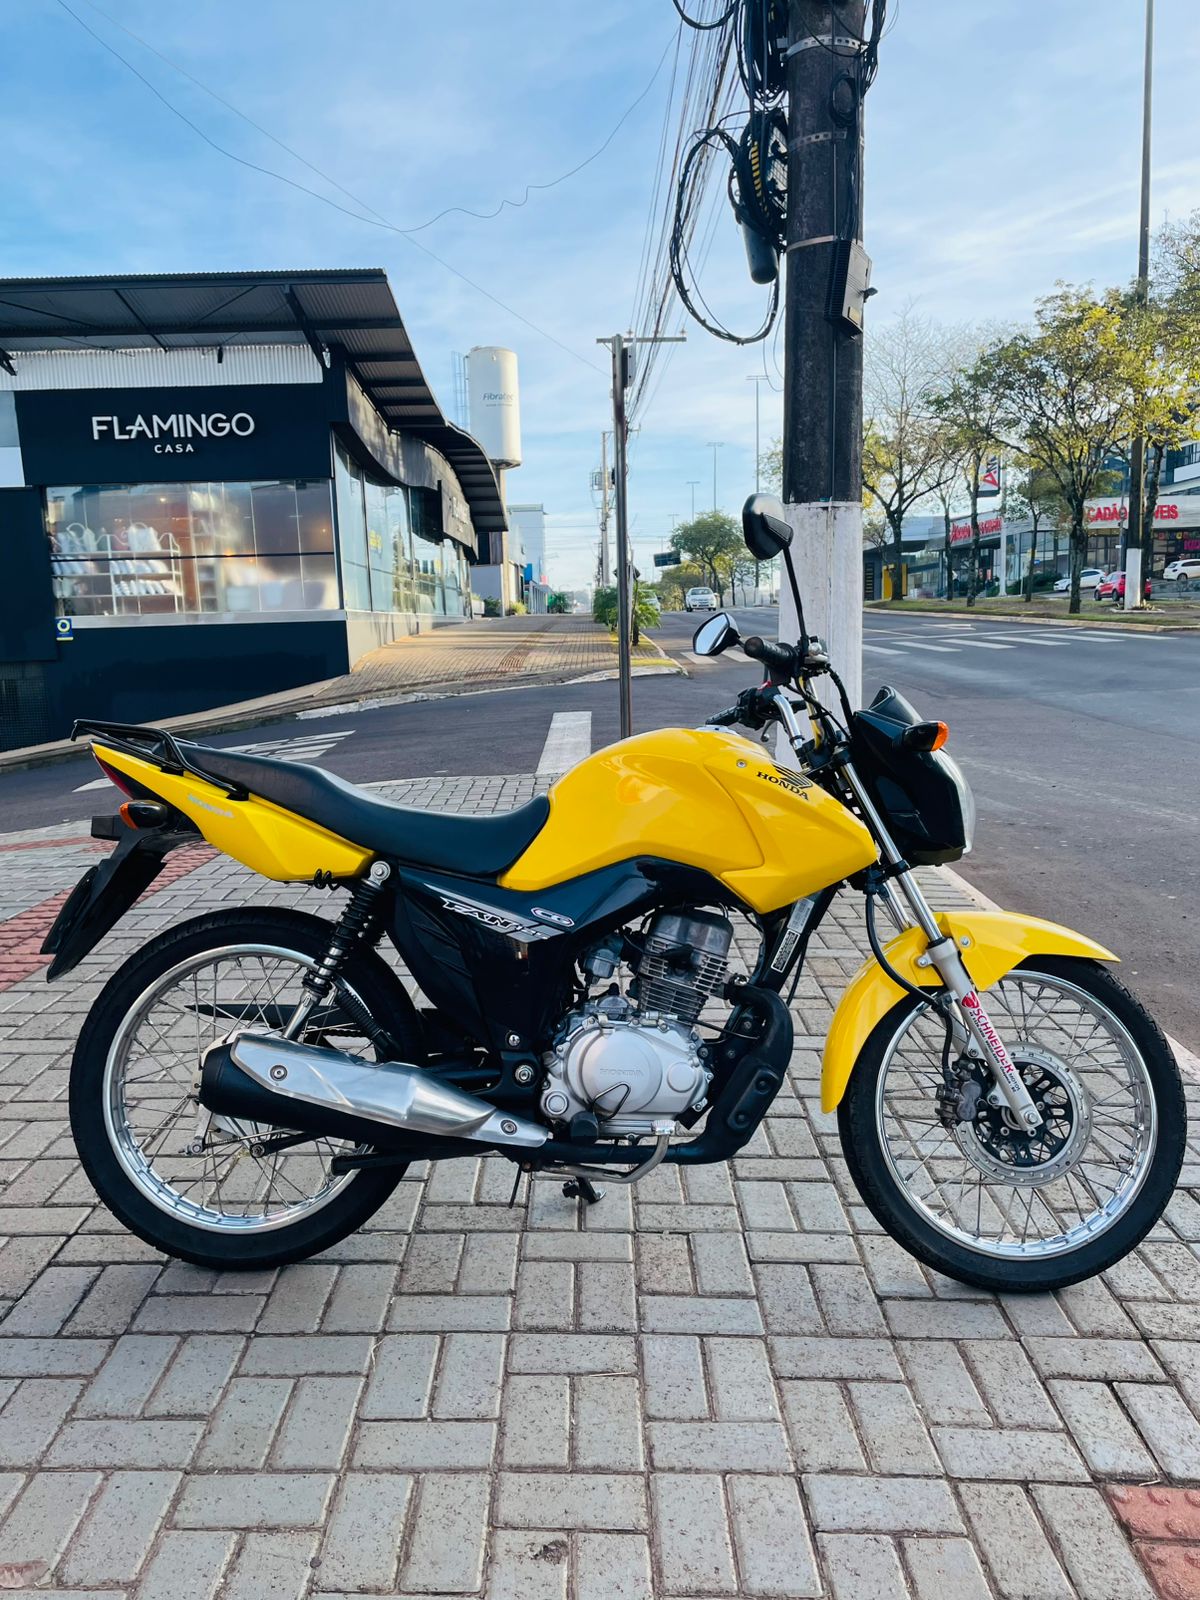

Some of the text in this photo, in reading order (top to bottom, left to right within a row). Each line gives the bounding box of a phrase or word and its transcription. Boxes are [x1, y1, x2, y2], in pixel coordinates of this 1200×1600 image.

[91, 412, 255, 440] FLAMINGO
[154, 443, 194, 454] CASA
[756, 771, 809, 801] HONDA
[440, 896, 520, 929] FAN
[972, 1008, 1014, 1073] SCHNEIDER
